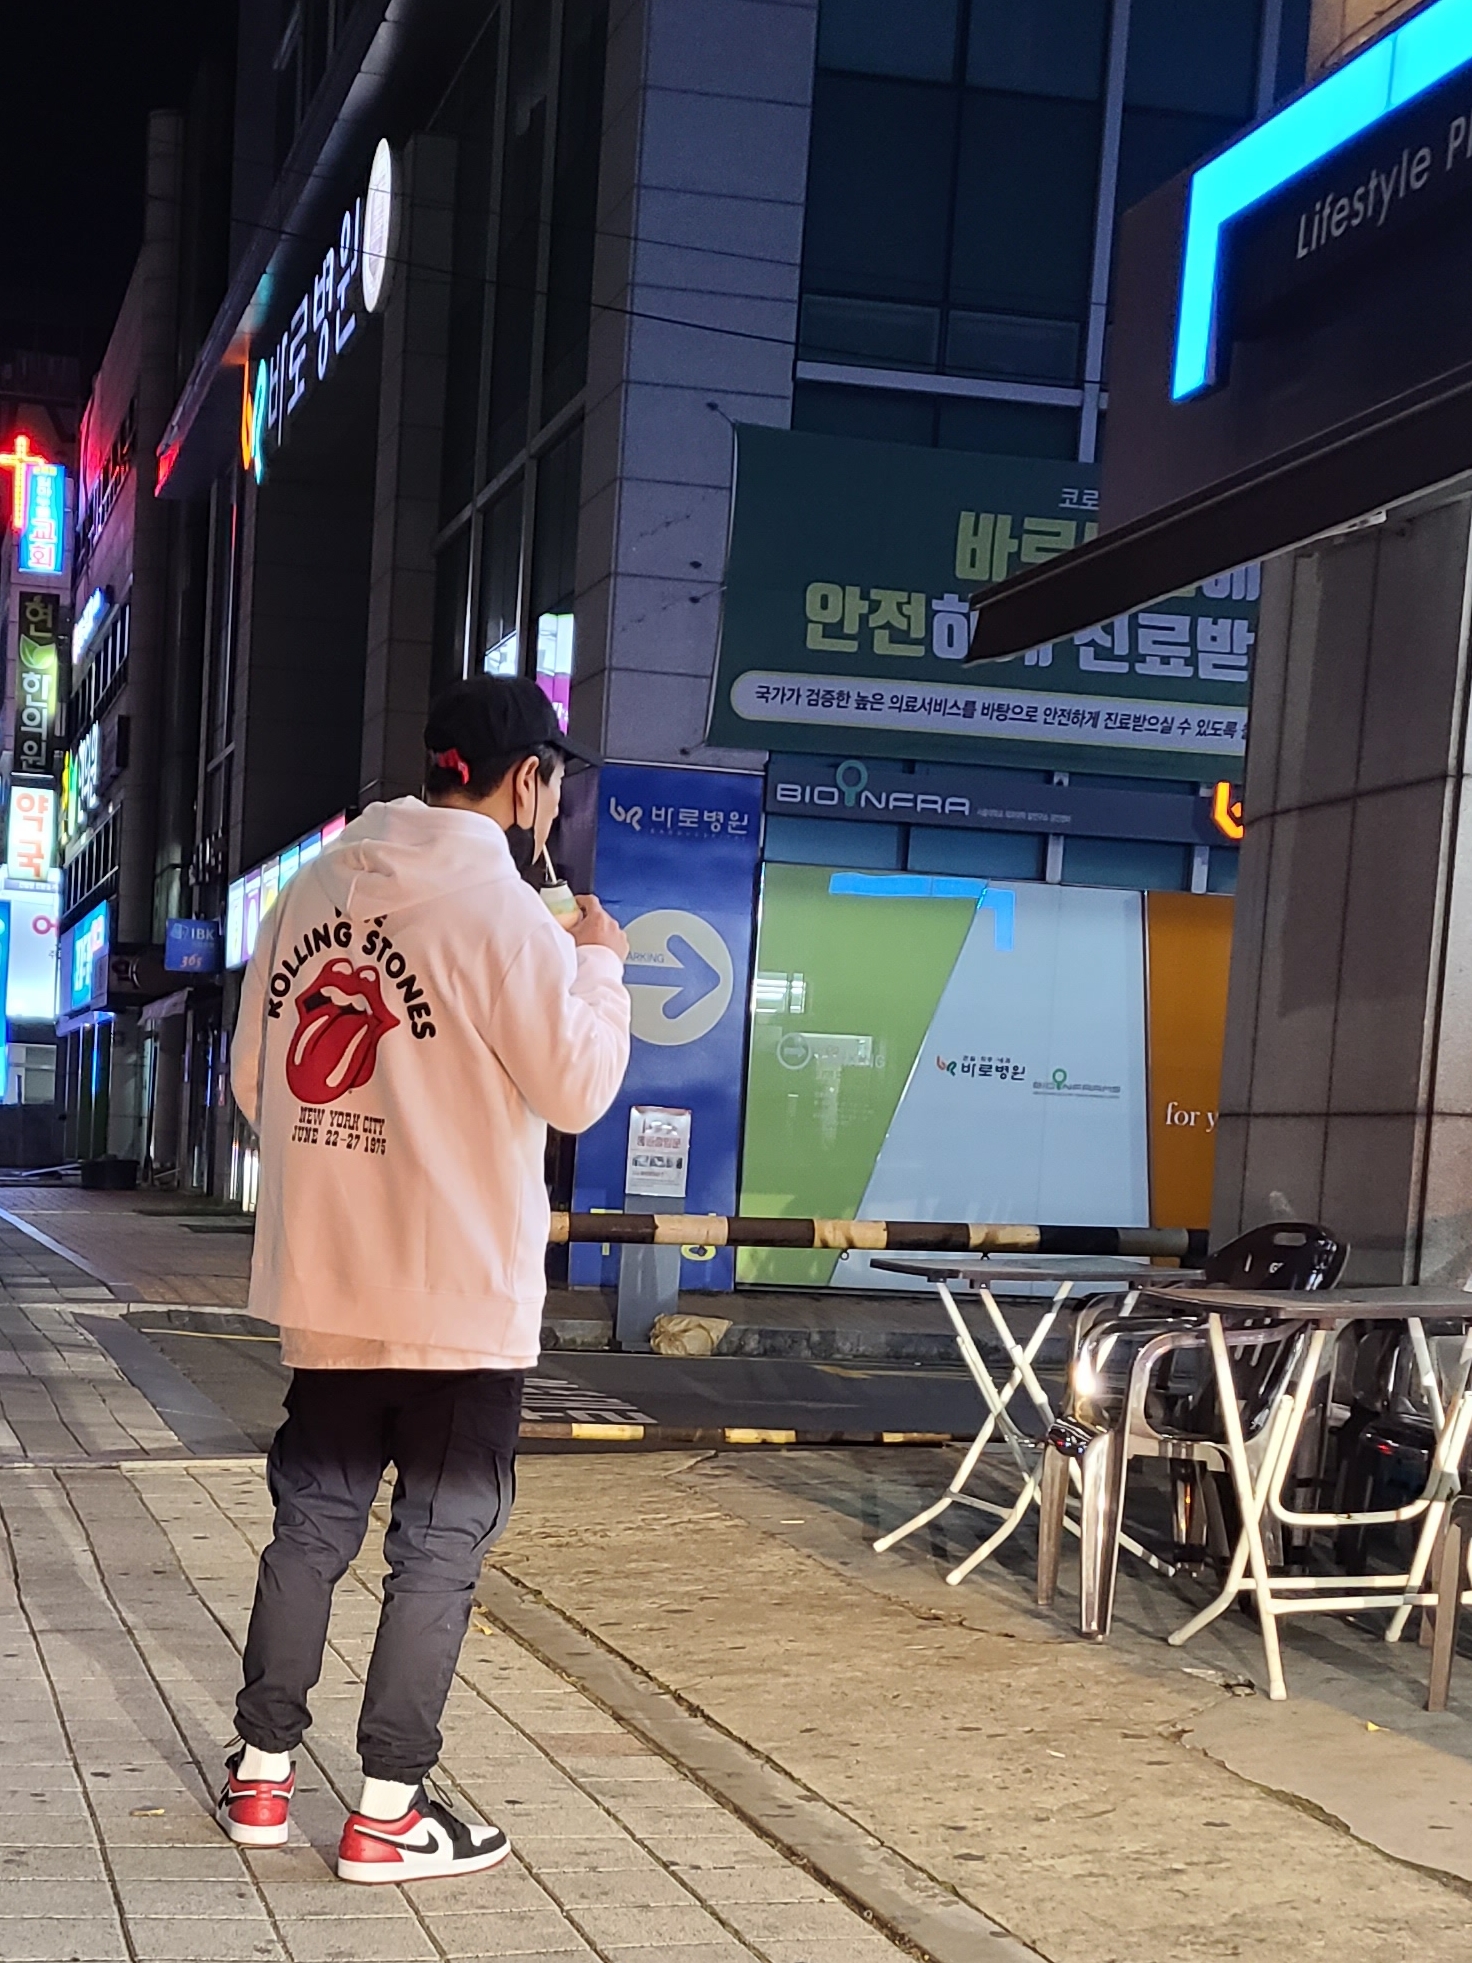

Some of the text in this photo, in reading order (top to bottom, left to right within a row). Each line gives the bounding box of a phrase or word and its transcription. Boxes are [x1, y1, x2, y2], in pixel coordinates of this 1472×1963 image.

[1296, 147, 1432, 259] Lifestyle
[25, 594, 53, 637] 현
[755, 685, 802, 705] 국가가
[805, 688, 851, 709] 검증한
[854, 691, 884, 711] 높은
[888, 694, 977, 719] 의료서비스를
[980, 701, 1038, 722] 바탕으로
[1043, 707, 1101, 729] 안전하게
[1103, 711, 1175, 735] 진료받으실
[1176, 719, 1192, 736] 수
[1196, 719, 1238, 740] 있도록
[16, 792, 50, 878] 약국
[651, 806, 749, 835] 바로병원
[191, 927, 215, 941] IBK
[179, 952, 204, 968] 365
[626, 951, 665, 963] ARKING
[362, 930, 436, 1040] STONES
[961, 1063, 1026, 1081] 바로병원
[299, 1106, 386, 1136] NEW YORK CITY
[1165, 1101, 1201, 1126] for
[291, 1125, 387, 1156] JUNE 22-27 1975
